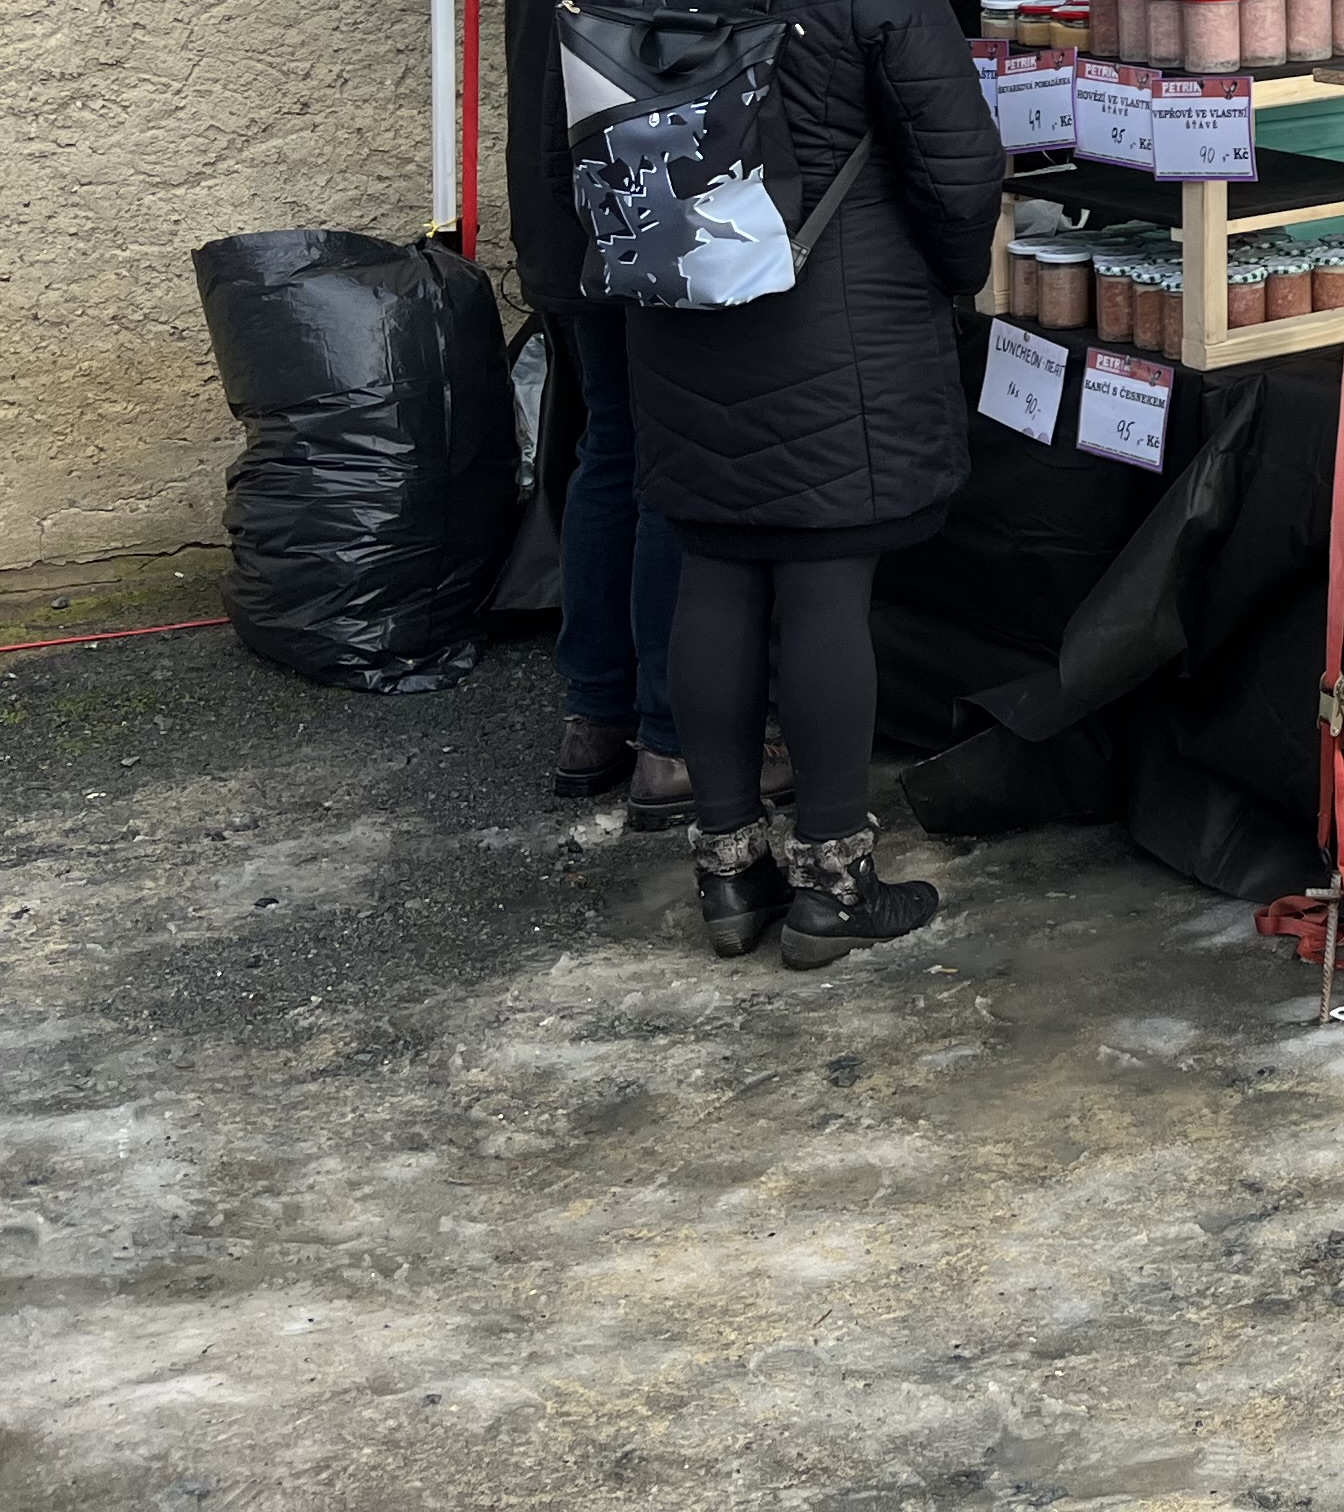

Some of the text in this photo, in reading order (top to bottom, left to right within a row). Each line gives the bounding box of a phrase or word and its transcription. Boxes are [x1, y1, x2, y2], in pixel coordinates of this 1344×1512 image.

[1005, 56, 1037, 74] PETRIK
[1085, 63, 1119, 82] PETRIK
[1162, 81, 1202, 96] PETRIK
[1060, 114, 1072, 127] Kč
[1139, 138, 1152, 150] Kč
[1200, 145, 1215, 163] 90
[1232, 148, 1249, 160] Kč
[1096, 354, 1131, 374] PETRIK
[1112, 385, 1118, 397] S
[1119, 384, 1166, 409] ČESNEKEM
[1116, 420, 1136, 441] 95
[1146, 434, 1161, 449] Kč
